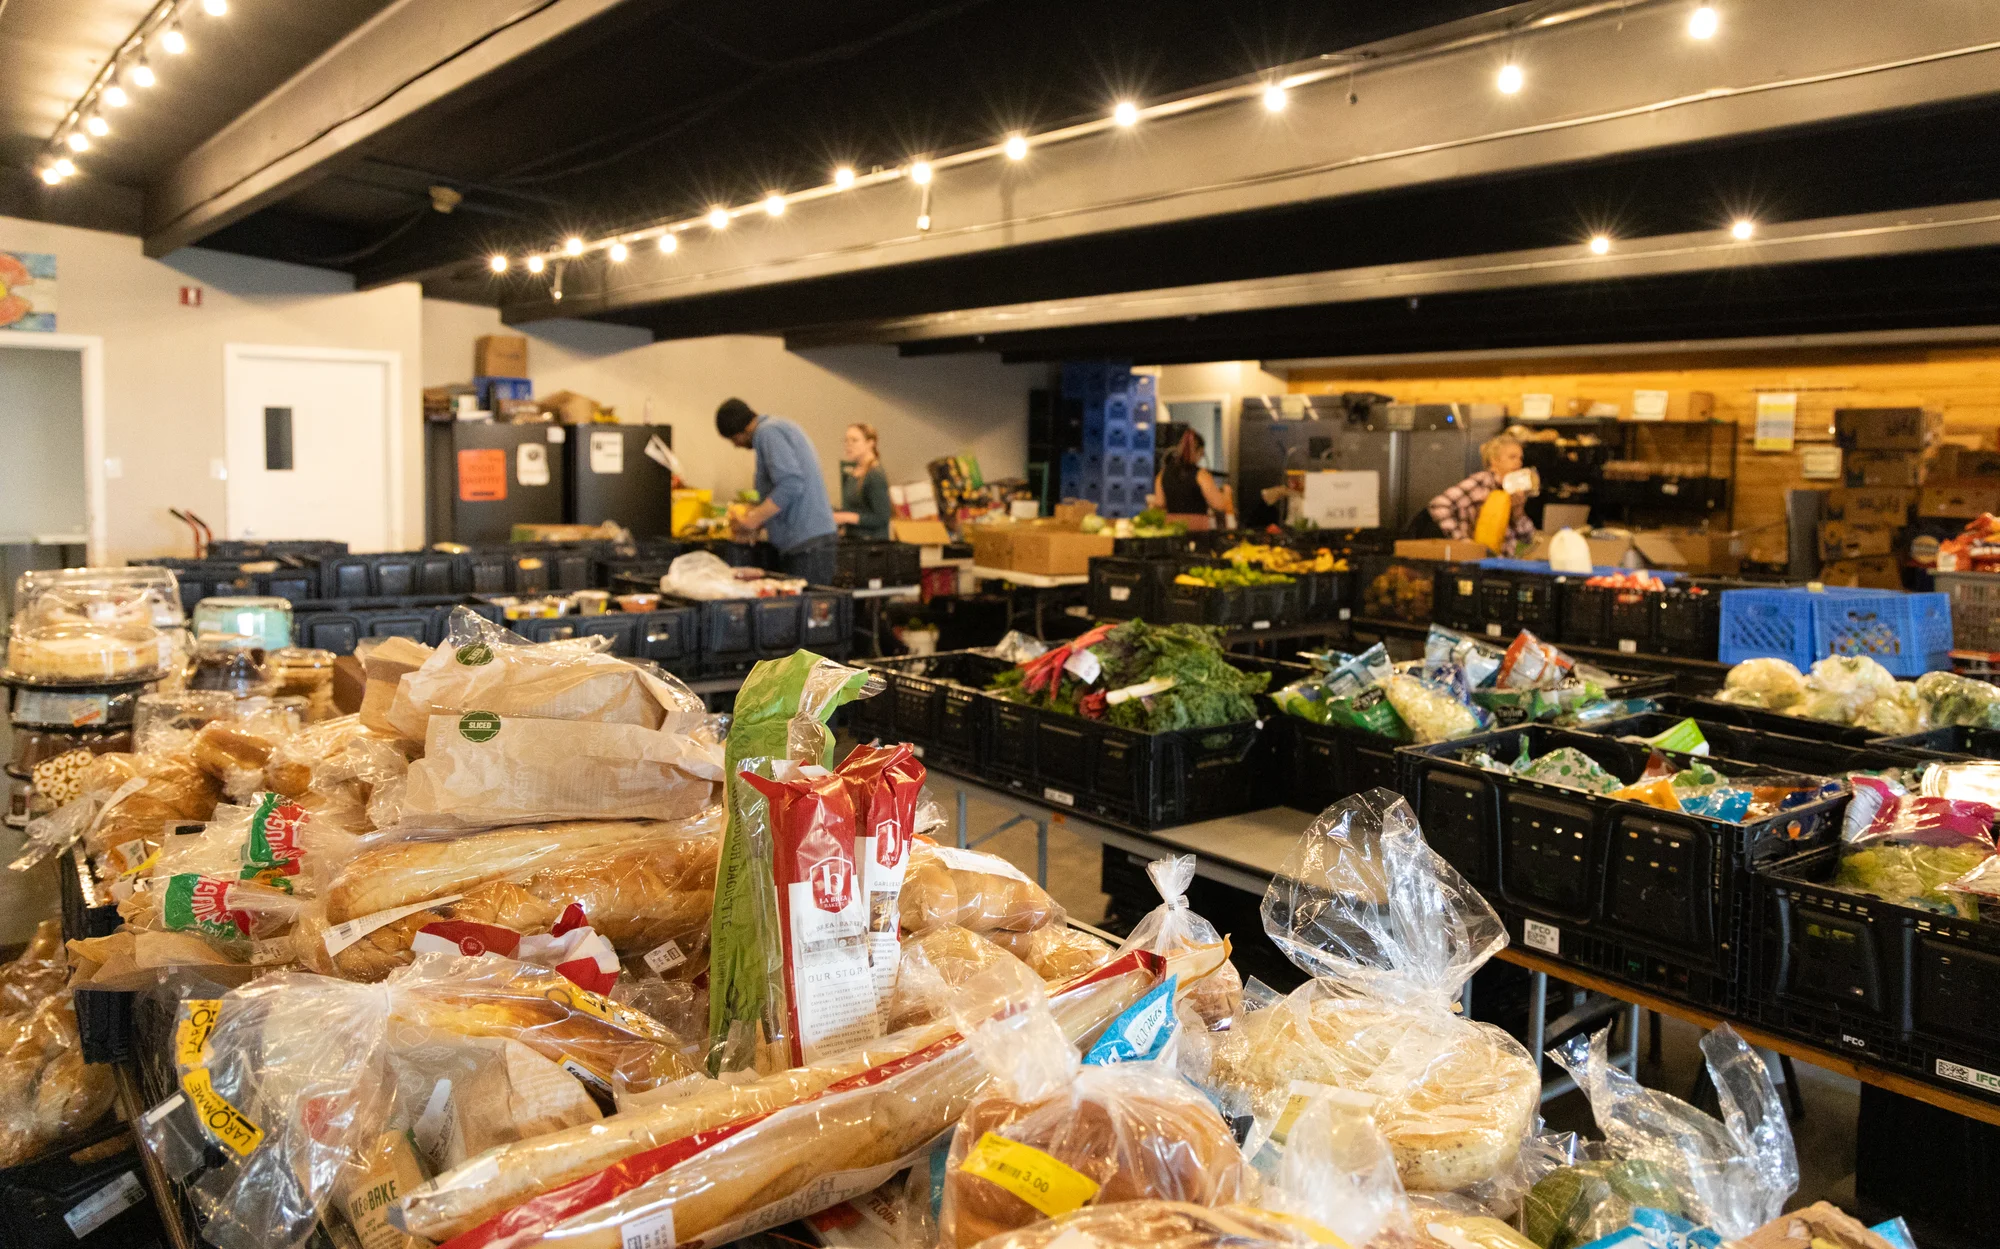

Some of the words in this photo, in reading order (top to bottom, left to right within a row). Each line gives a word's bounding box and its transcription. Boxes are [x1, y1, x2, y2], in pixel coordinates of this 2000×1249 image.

[468, 721, 492, 729] SLICED
[720, 864, 741, 931] BAGUETTE
[1530, 923, 1551, 935] IFCO
[808, 971, 831, 983] OUR
[835, 966, 869, 979] STORY
[1136, 1007, 1163, 1047] SPROUTS
[1843, 1034, 1865, 1047] IFCO
[190, 1082, 251, 1147] LAROMME
[1022, 1171, 1050, 1193] 3.00
[367, 1180, 398, 1211] BAKE
